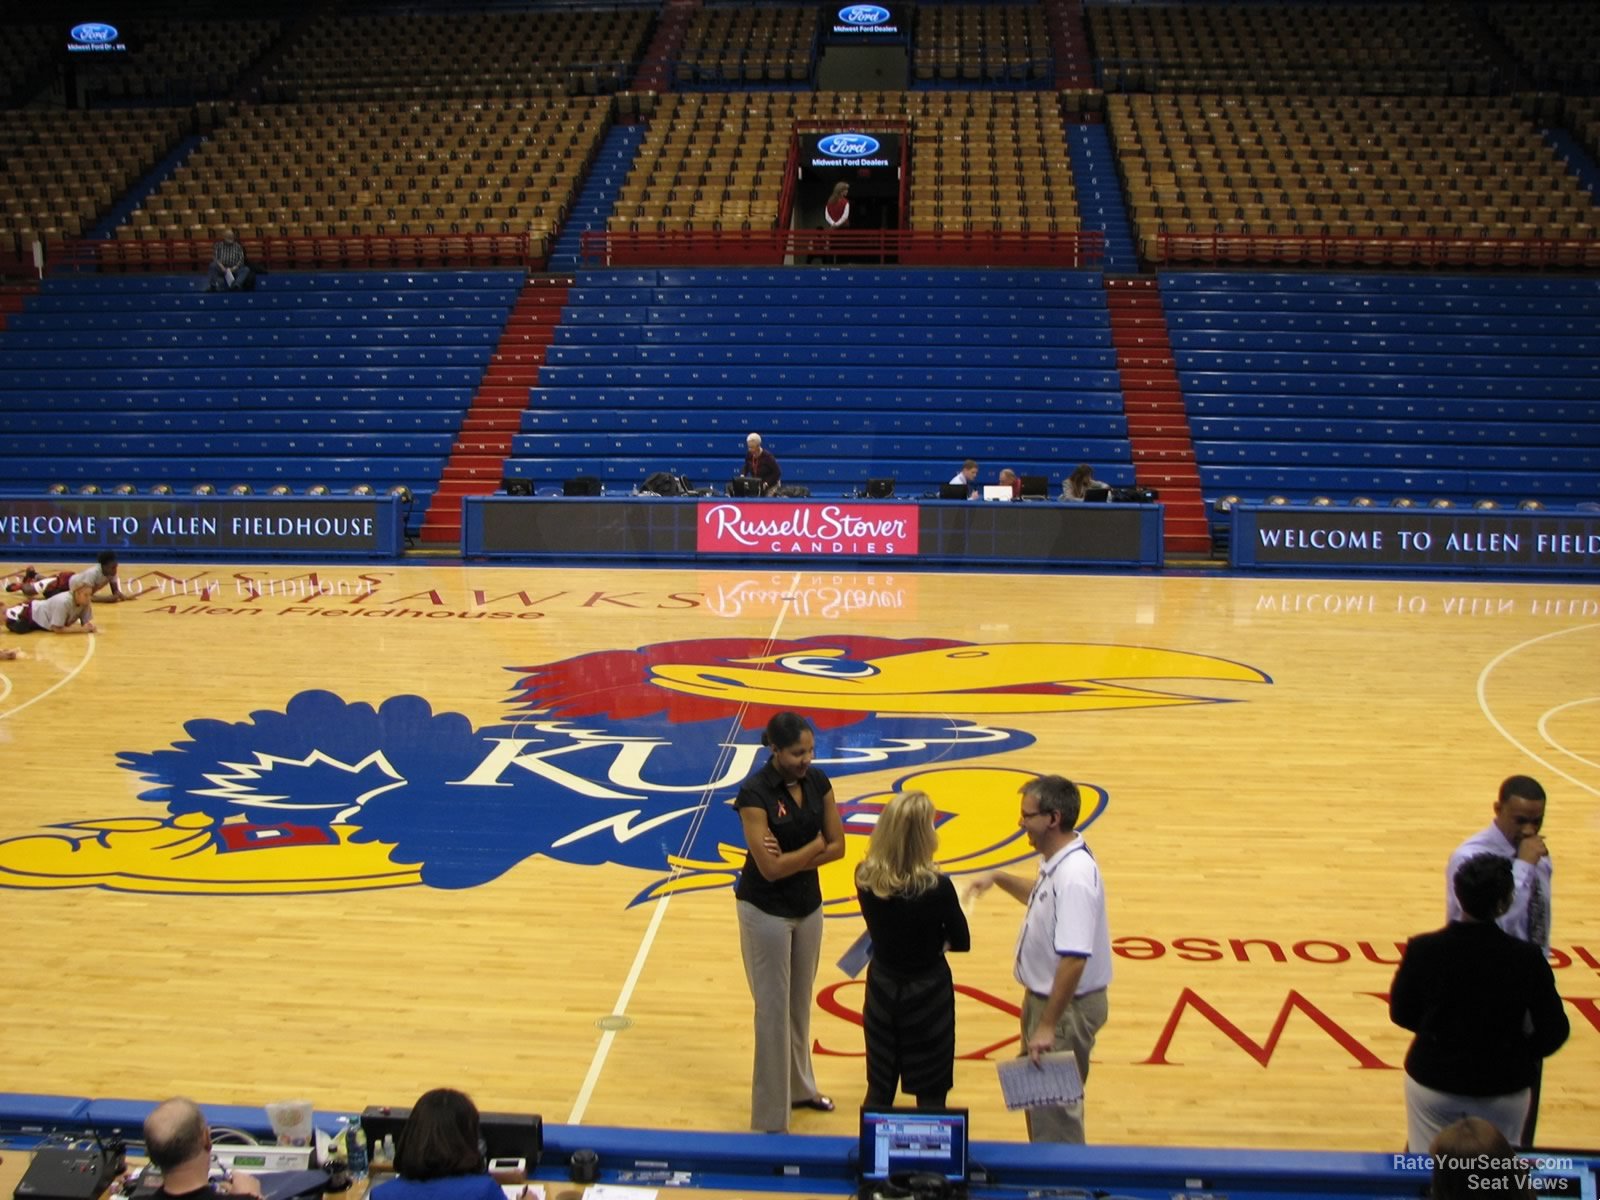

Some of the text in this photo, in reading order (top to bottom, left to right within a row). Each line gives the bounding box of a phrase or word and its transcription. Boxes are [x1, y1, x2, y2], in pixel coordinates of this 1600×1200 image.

[848, 8, 880, 21] Ford
[80, 27, 109, 40] Ford
[829, 136, 867, 153] Ford
[109, 516, 138, 535] TO
[152, 517, 217, 535] ALLEN
[232, 517, 374, 537] FIELDHOUSE
[705, 504, 907, 546] Russell Stover
[771, 541, 894, 553] CANDIES
[1260, 528, 1600, 554] WELCOME TO ALLEN FIELD
[144, 605, 545, 620] Allen Fieldhouse
[445, 737, 767, 800] KU
